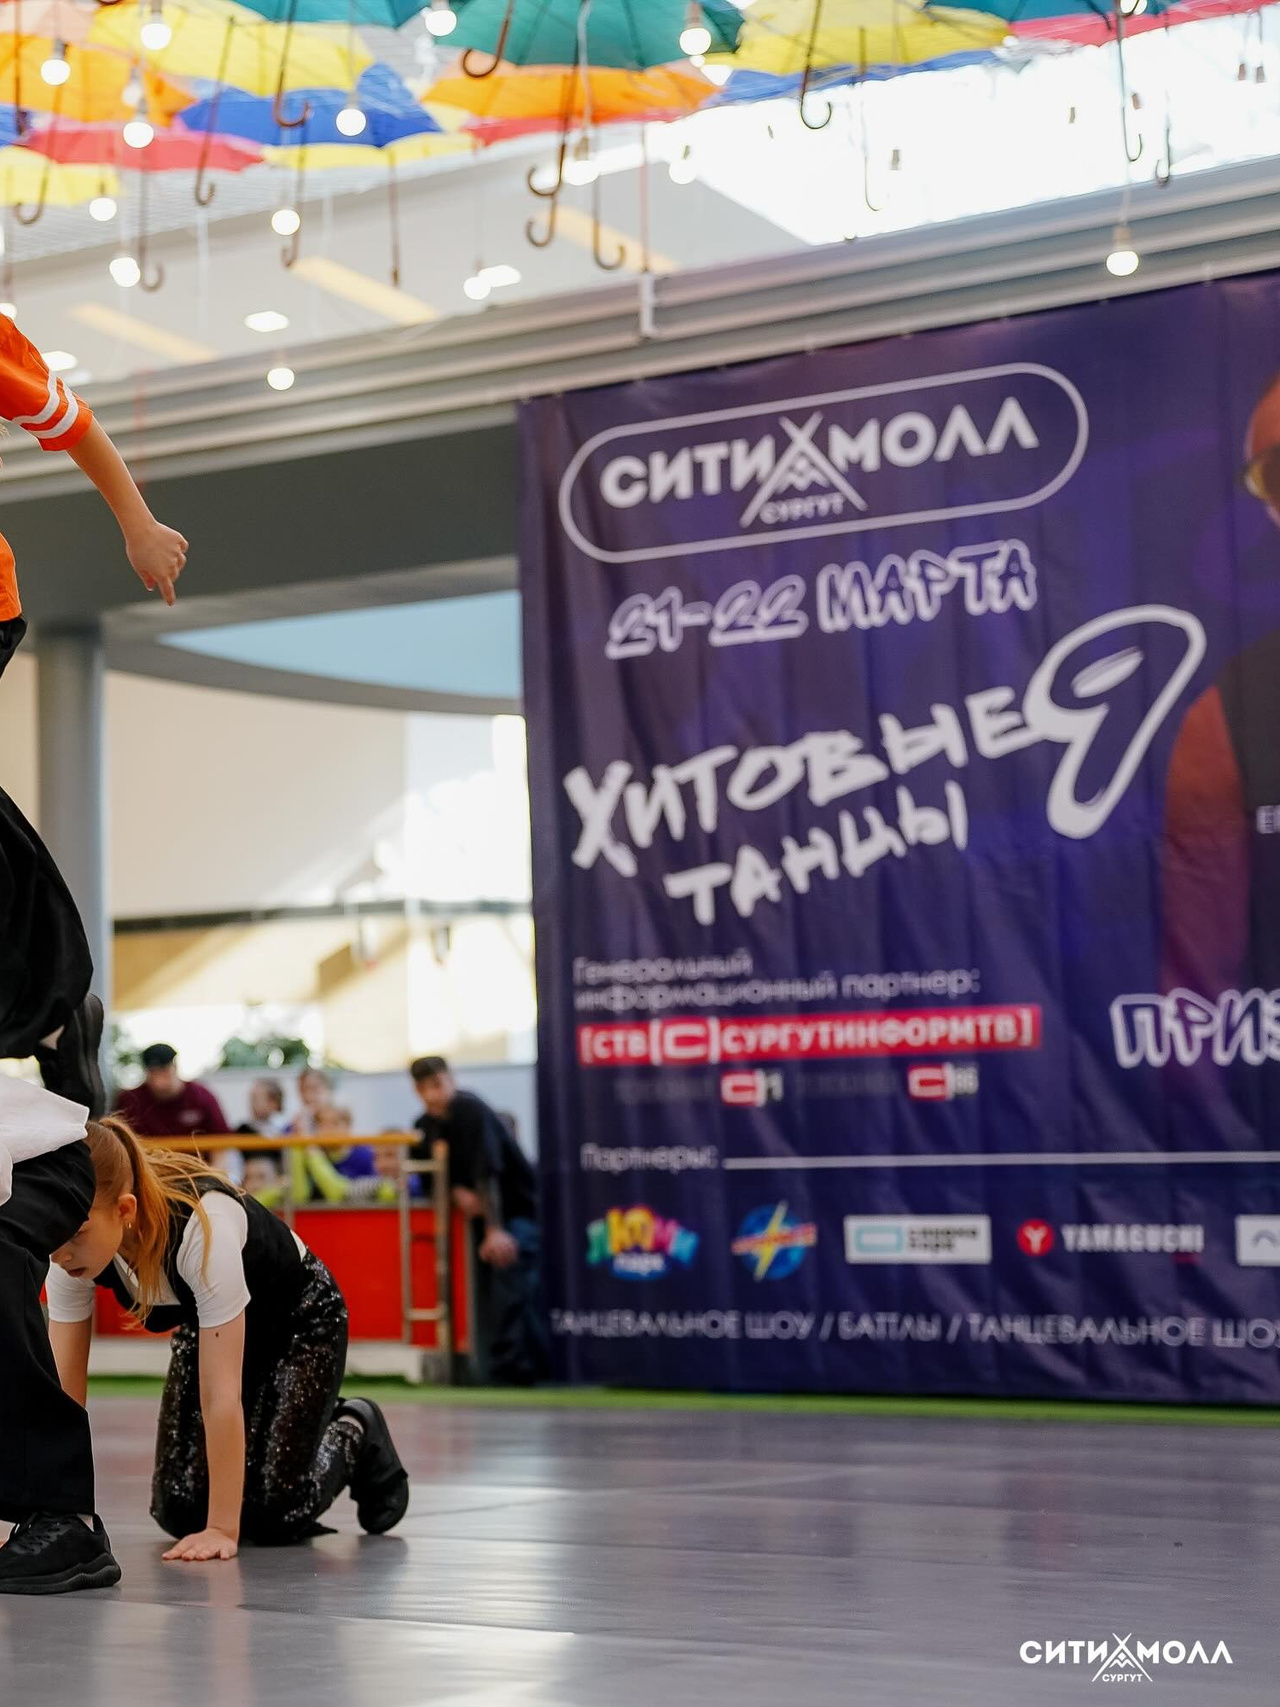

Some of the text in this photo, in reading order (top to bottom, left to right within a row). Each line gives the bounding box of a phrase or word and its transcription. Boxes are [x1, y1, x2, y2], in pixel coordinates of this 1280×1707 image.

[599, 396, 1039, 508] СИТИ МОЛЛ
[817, 538, 1037, 633] МАРТА
[564, 685, 1036, 878] ХИТОВЫЕ
[666, 780, 968, 926] ТАНЦЫ
[965, 1312, 1207, 1347] ТАНЦЕВАЛЬНОЕ
